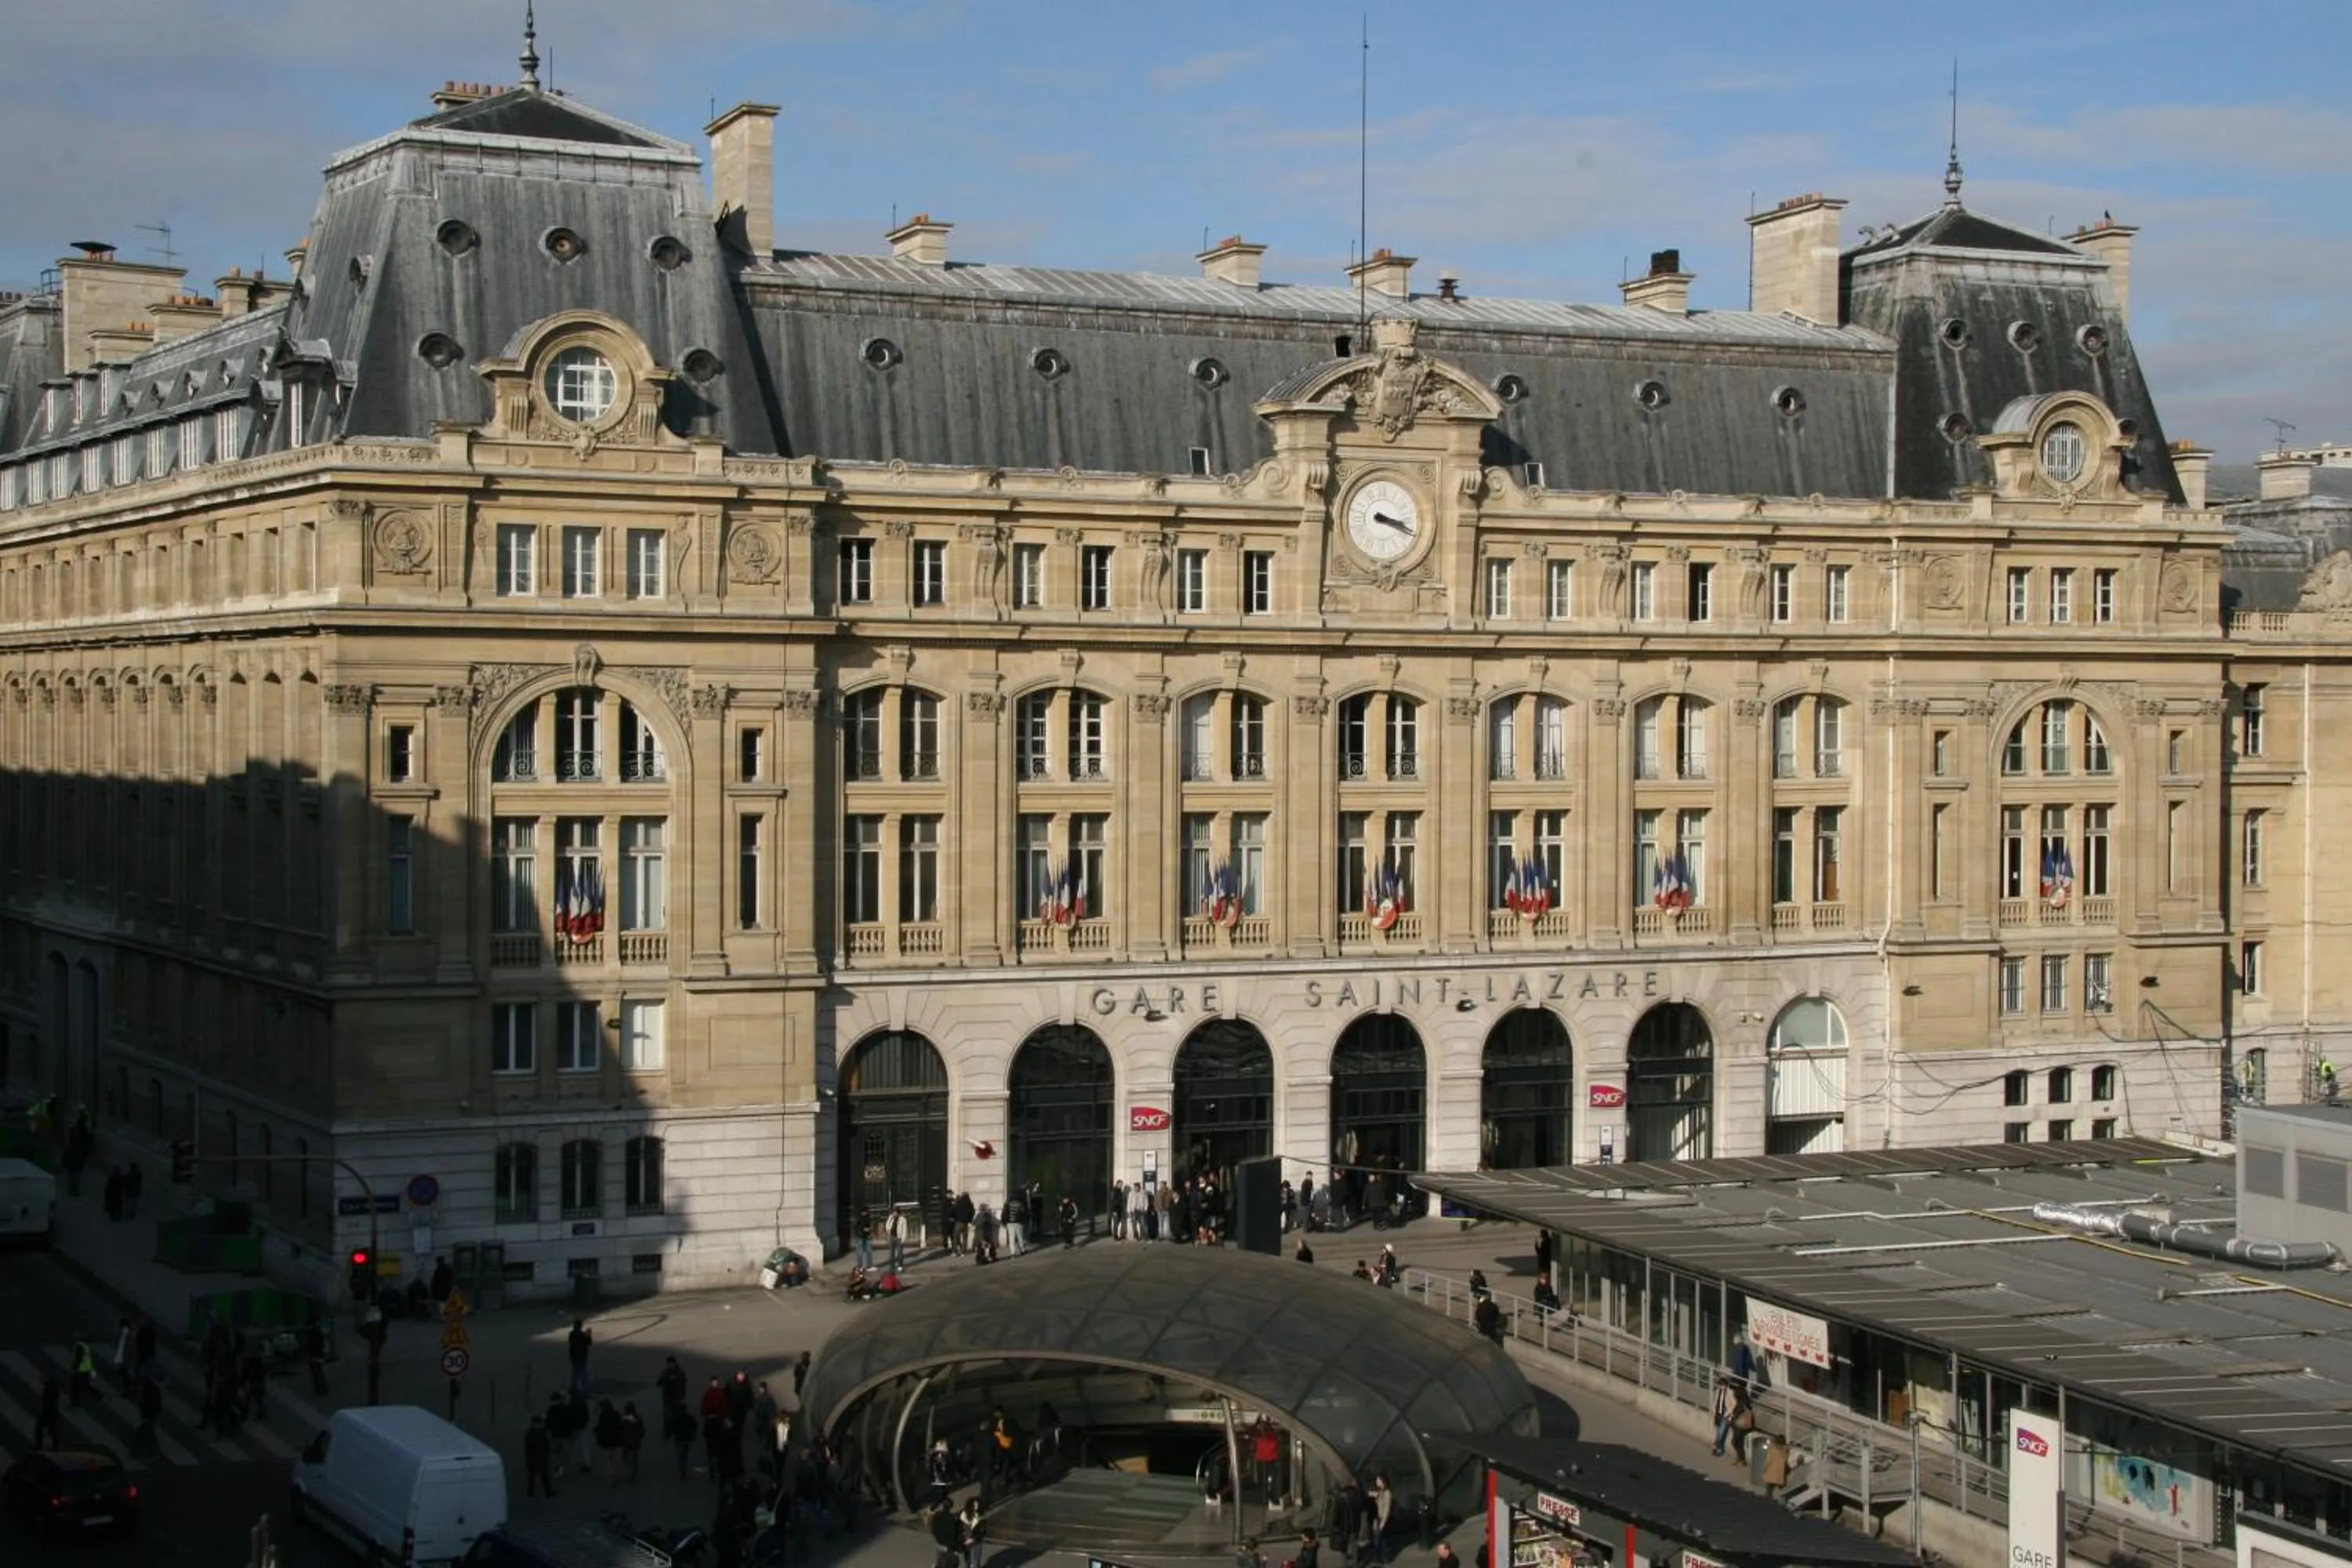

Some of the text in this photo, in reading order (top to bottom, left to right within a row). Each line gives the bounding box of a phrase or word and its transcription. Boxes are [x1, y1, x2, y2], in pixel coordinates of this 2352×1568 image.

[1093, 985, 1217, 1016] GARE
[1592, 1091, 1623, 1105] SNCF
[1132, 1114, 1167, 1127] SNCF
[446, 1355, 464, 1367] 30
[2018, 1437, 2047, 1454] SNCF
